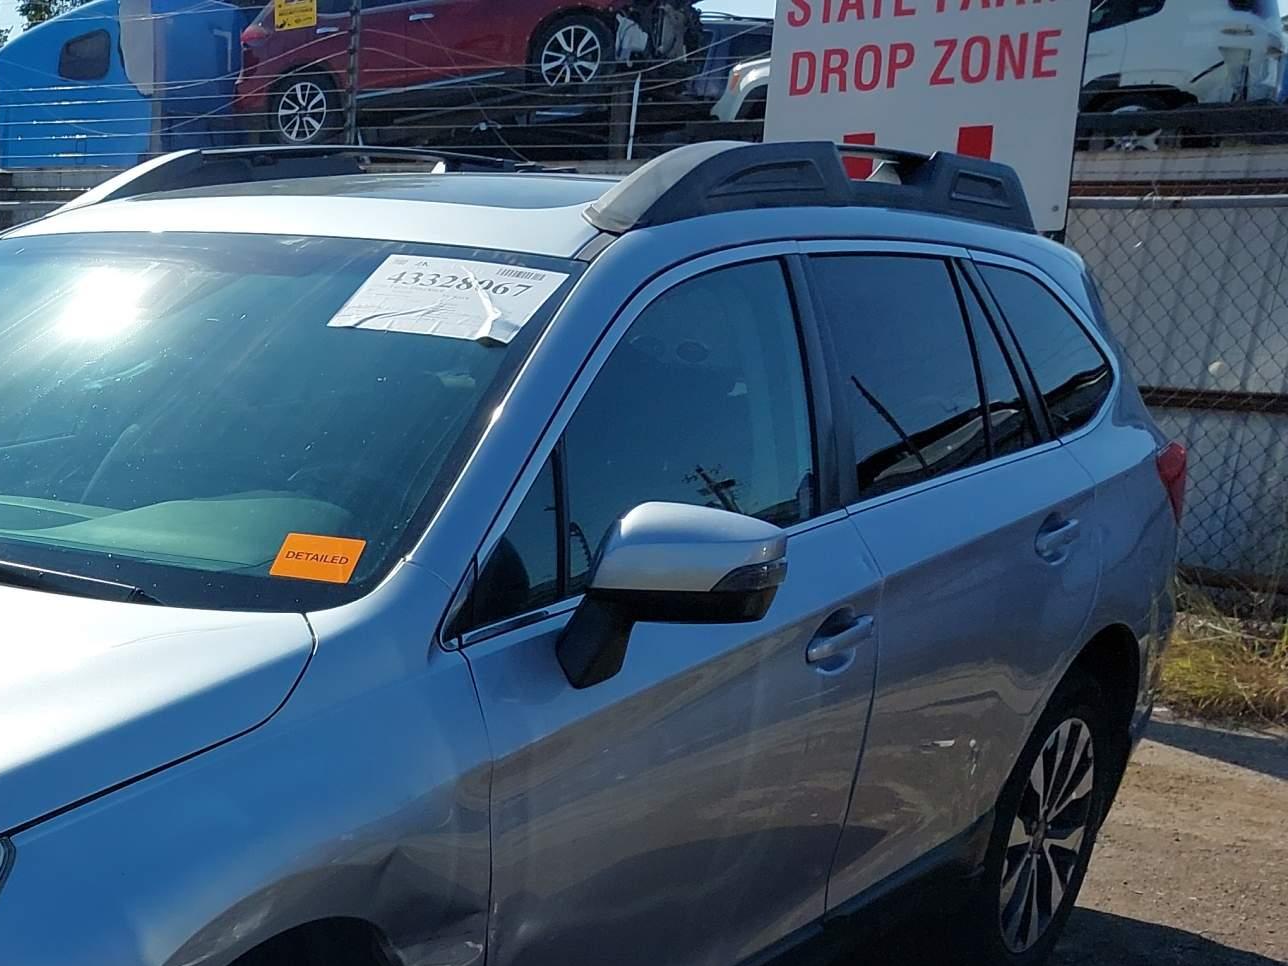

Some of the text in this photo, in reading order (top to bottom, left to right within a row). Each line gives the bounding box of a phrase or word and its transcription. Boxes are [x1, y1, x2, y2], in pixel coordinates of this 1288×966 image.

[789, 29, 1063, 97] DROP ZONE
[285, 550, 349, 565] DETAILED
